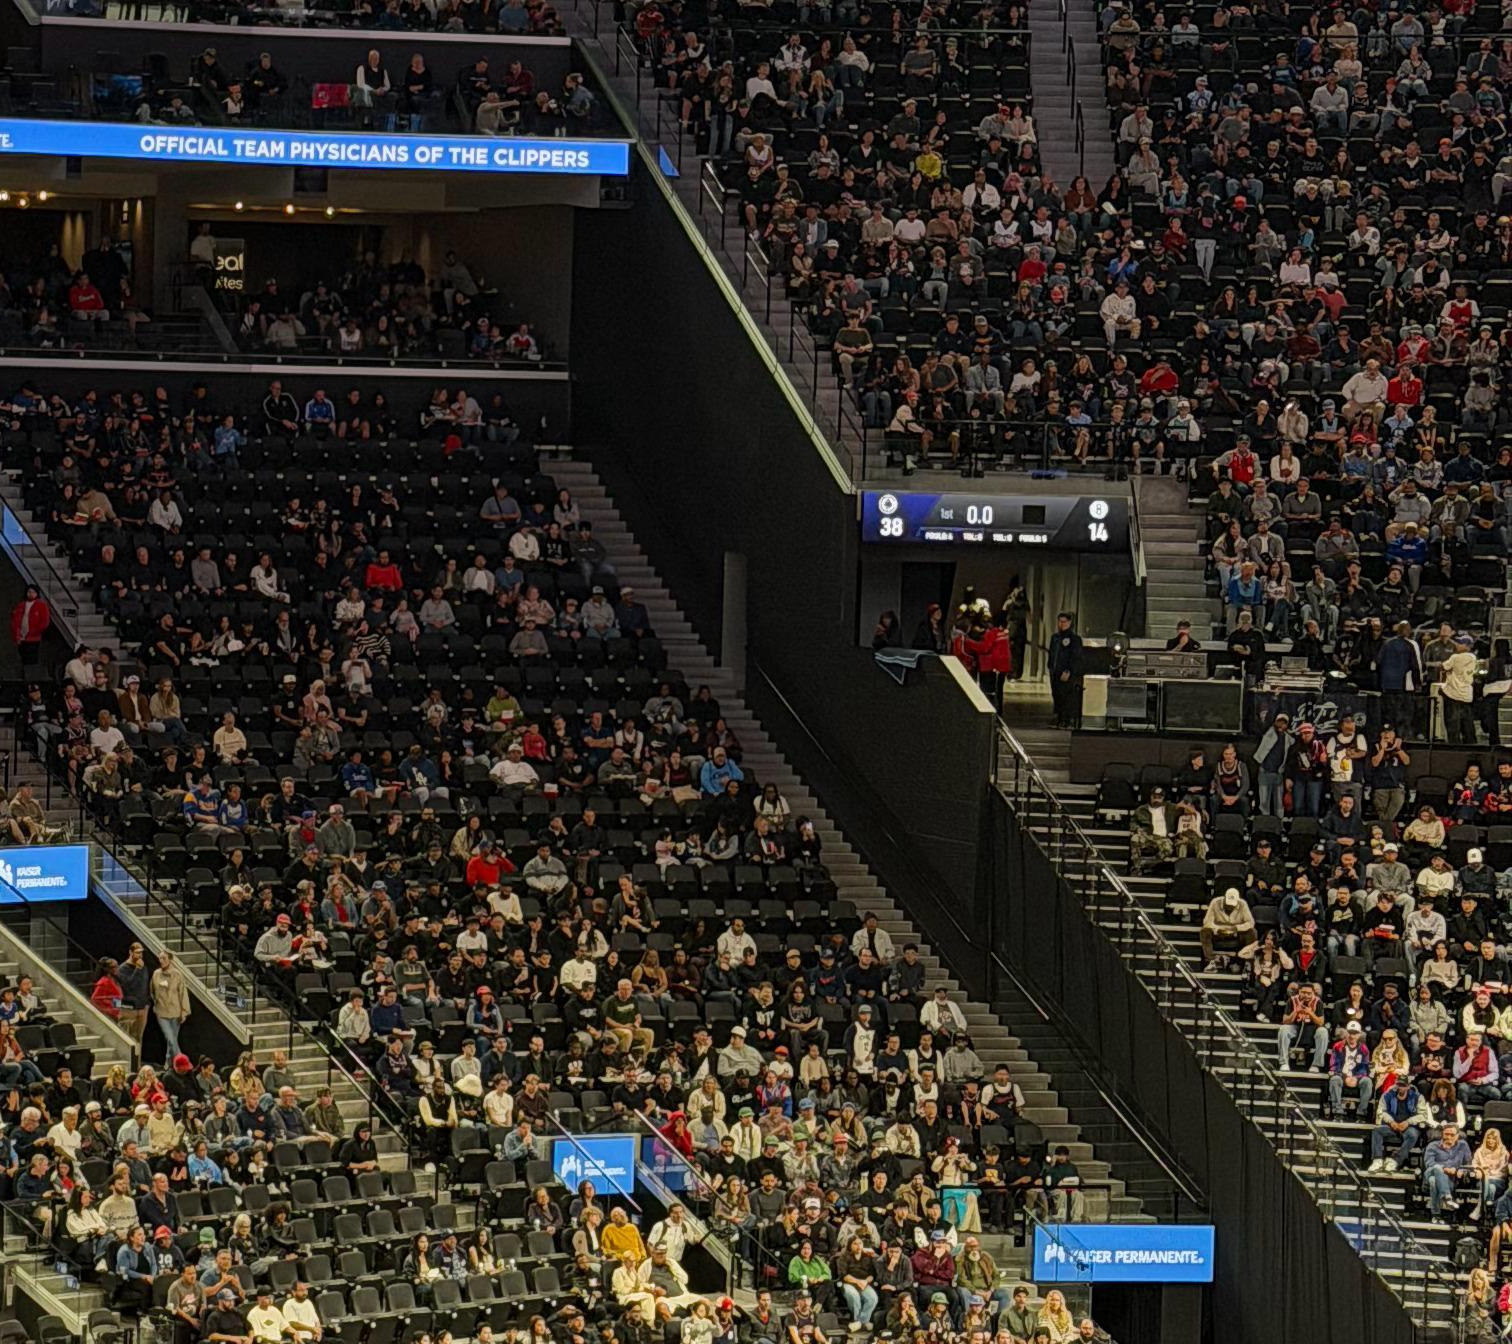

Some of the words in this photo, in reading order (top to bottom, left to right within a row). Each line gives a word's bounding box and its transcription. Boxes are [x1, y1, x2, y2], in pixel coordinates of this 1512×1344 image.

[140, 135, 228, 156] OFFICIAL
[233, 139, 285, 159] TEAM
[290, 143, 408, 164] PHYSICIANS
[415, 146, 443, 165] OF
[449, 148, 489, 166] THE
[494, 148, 589, 169] CLIPPERS
[967, 505, 993, 525] 0.0
[880, 517, 903, 537] 38
[1088, 523, 1108, 542] 14
